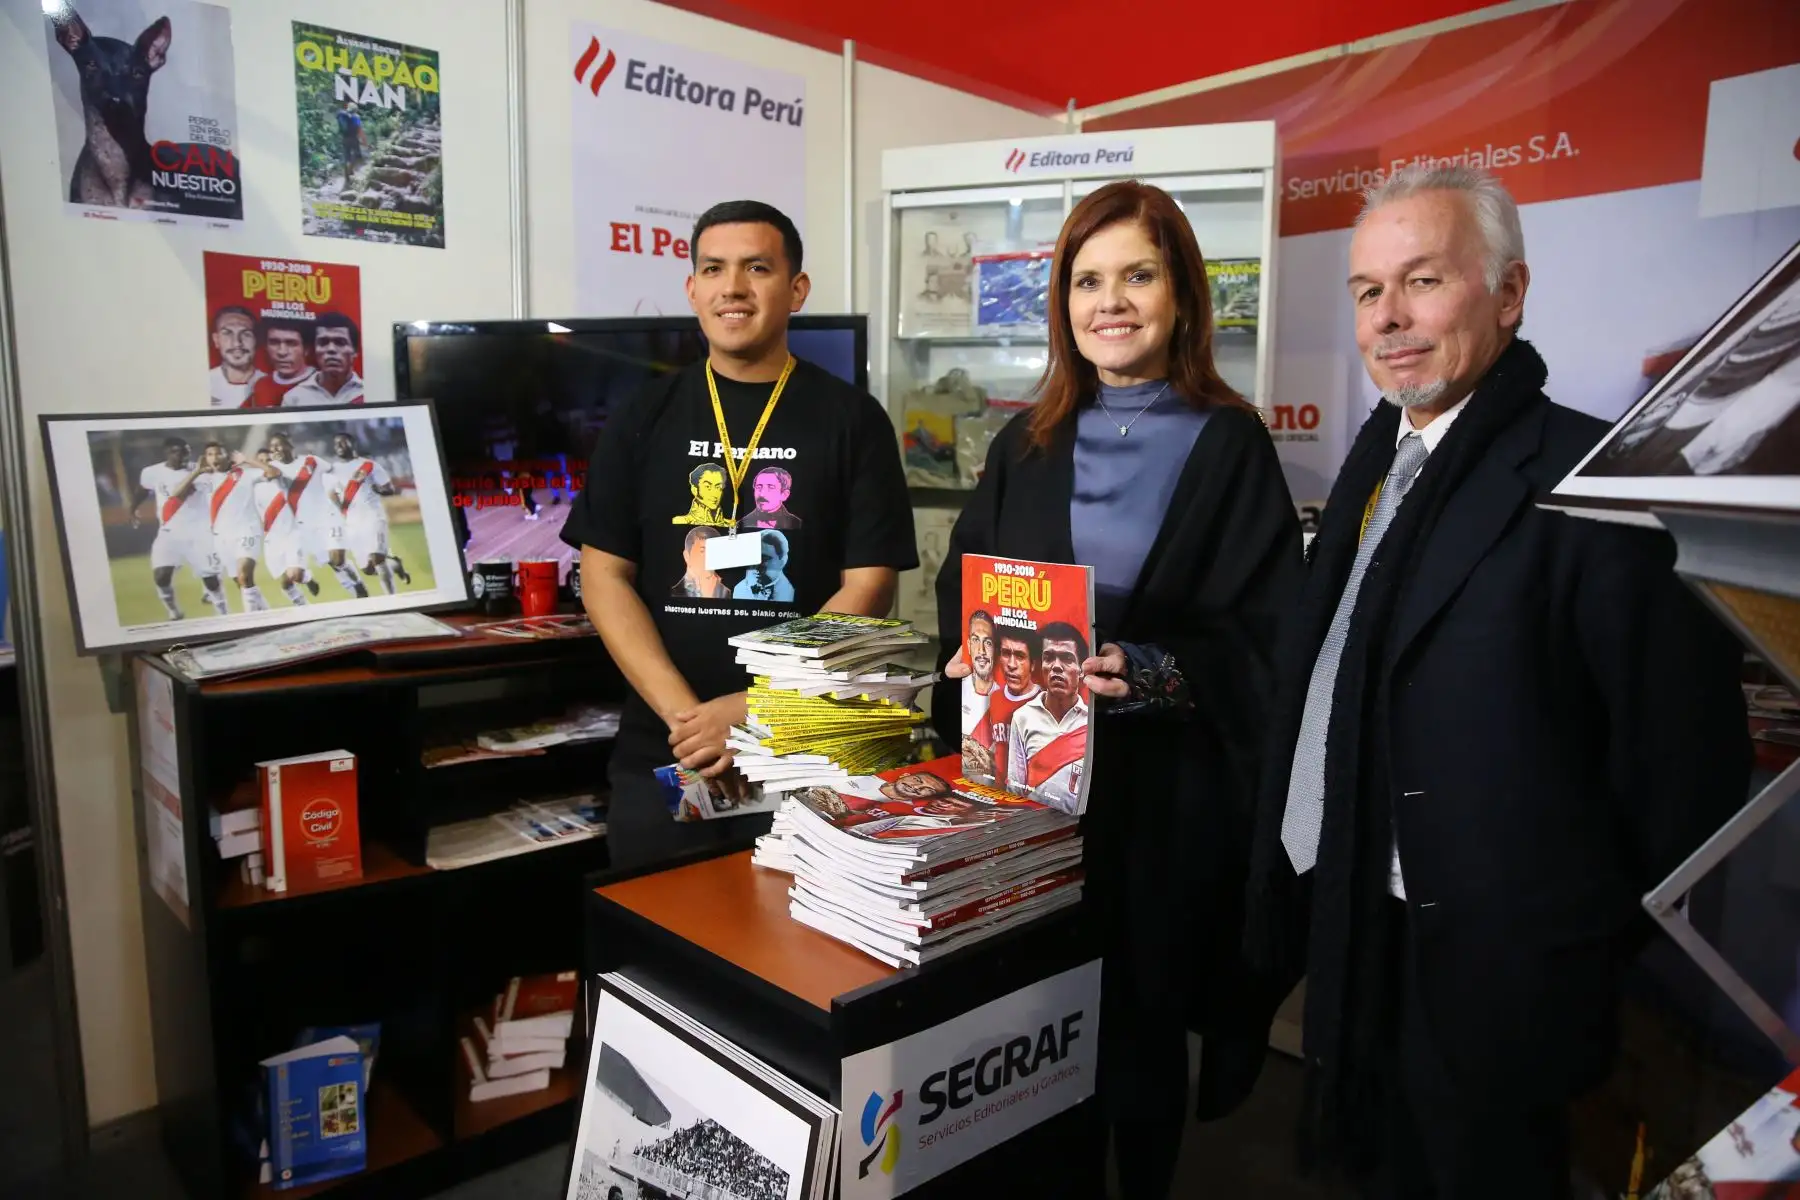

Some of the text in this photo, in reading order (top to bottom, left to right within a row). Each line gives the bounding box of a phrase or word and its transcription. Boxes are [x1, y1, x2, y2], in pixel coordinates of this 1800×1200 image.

[296, 40, 438, 93] QHAPAQ
[335, 67, 406, 111] ÑAN
[624, 59, 804, 127] Editora Perú
[150, 140, 234, 178] CAN
[1029, 146, 1134, 167] Editora Perú
[1288, 165, 1385, 200] Servicios
[1528, 131, 1580, 163] S.A.
[152, 170, 236, 194] NUESTRO
[610, 221, 690, 259] El Pe
[241, 268, 331, 305] PERÚ
[260, 308, 316, 320] MUNDIALES
[1270, 403, 1320, 430] no
[688, 440, 709, 457] El
[994, 562, 1035, 577] 1930-2018
[982, 570, 1052, 612] PERÚ
[993, 615, 1037, 631] MUNDIALES
[1001, 607, 1027, 619] EN LOS
[303, 808, 338, 820] Código
[311, 821, 333, 832] Civil
[918, 1010, 1083, 1125] SEGRAF
[919, 1117, 972, 1149] Servicios
[974, 1089, 1030, 1122] Editoriales
[1032, 1085, 1040, 1098] y
